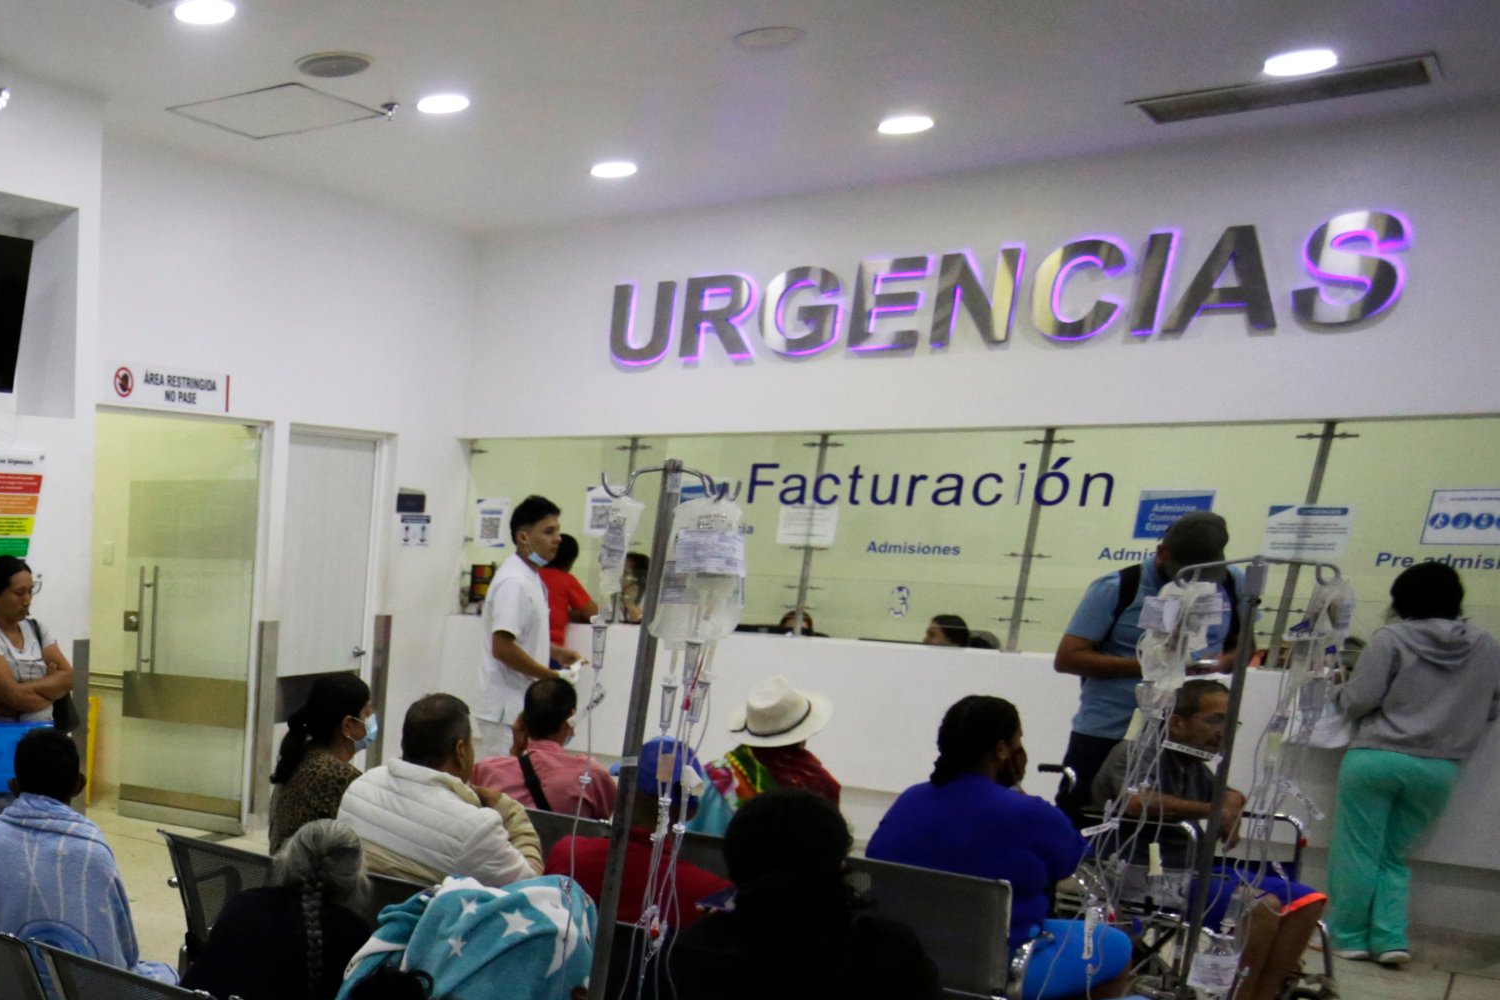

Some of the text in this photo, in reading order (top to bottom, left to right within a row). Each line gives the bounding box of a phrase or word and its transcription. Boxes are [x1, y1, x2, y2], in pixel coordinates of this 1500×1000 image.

[608, 209, 1411, 367] URGENCIAS
[143, 368, 217, 392] ÁREA RESTRINGIDA
[164, 389, 197, 405] NO PASE
[746, 456, 1115, 508] Facturación
[866, 540, 961, 556] Admisiones
[1098, 546, 1157, 561] Admis
[1375, 551, 1414, 569] Pre
[888, 586, 911, 619] 3
